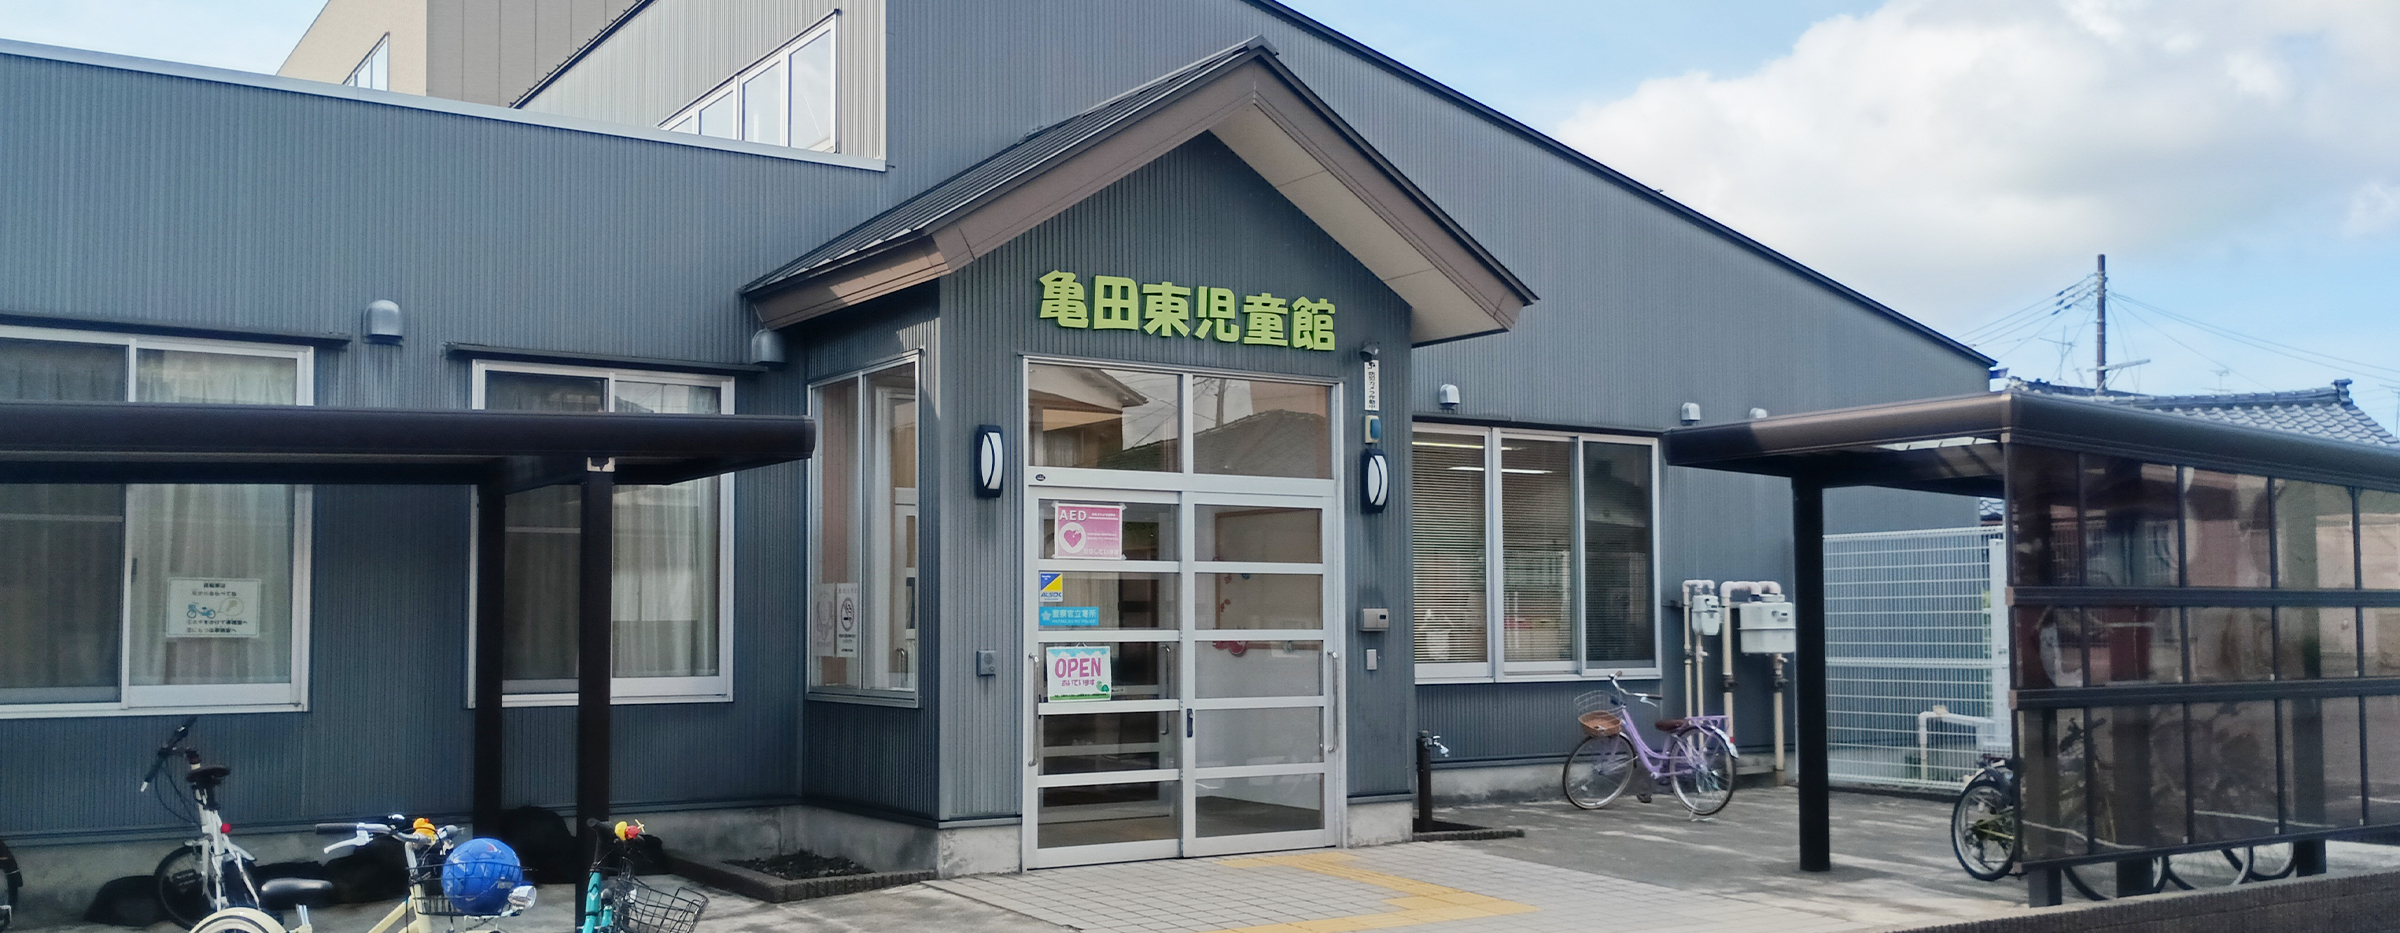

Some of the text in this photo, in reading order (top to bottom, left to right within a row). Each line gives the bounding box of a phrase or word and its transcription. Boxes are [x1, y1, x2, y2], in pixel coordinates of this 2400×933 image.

[1039, 270, 1336, 351] 亀田東児童館
[1059, 509, 1087, 522] AED
[1052, 609, 1097, 618] 警察官立寄所
[1055, 657, 1101, 678] OPEN
